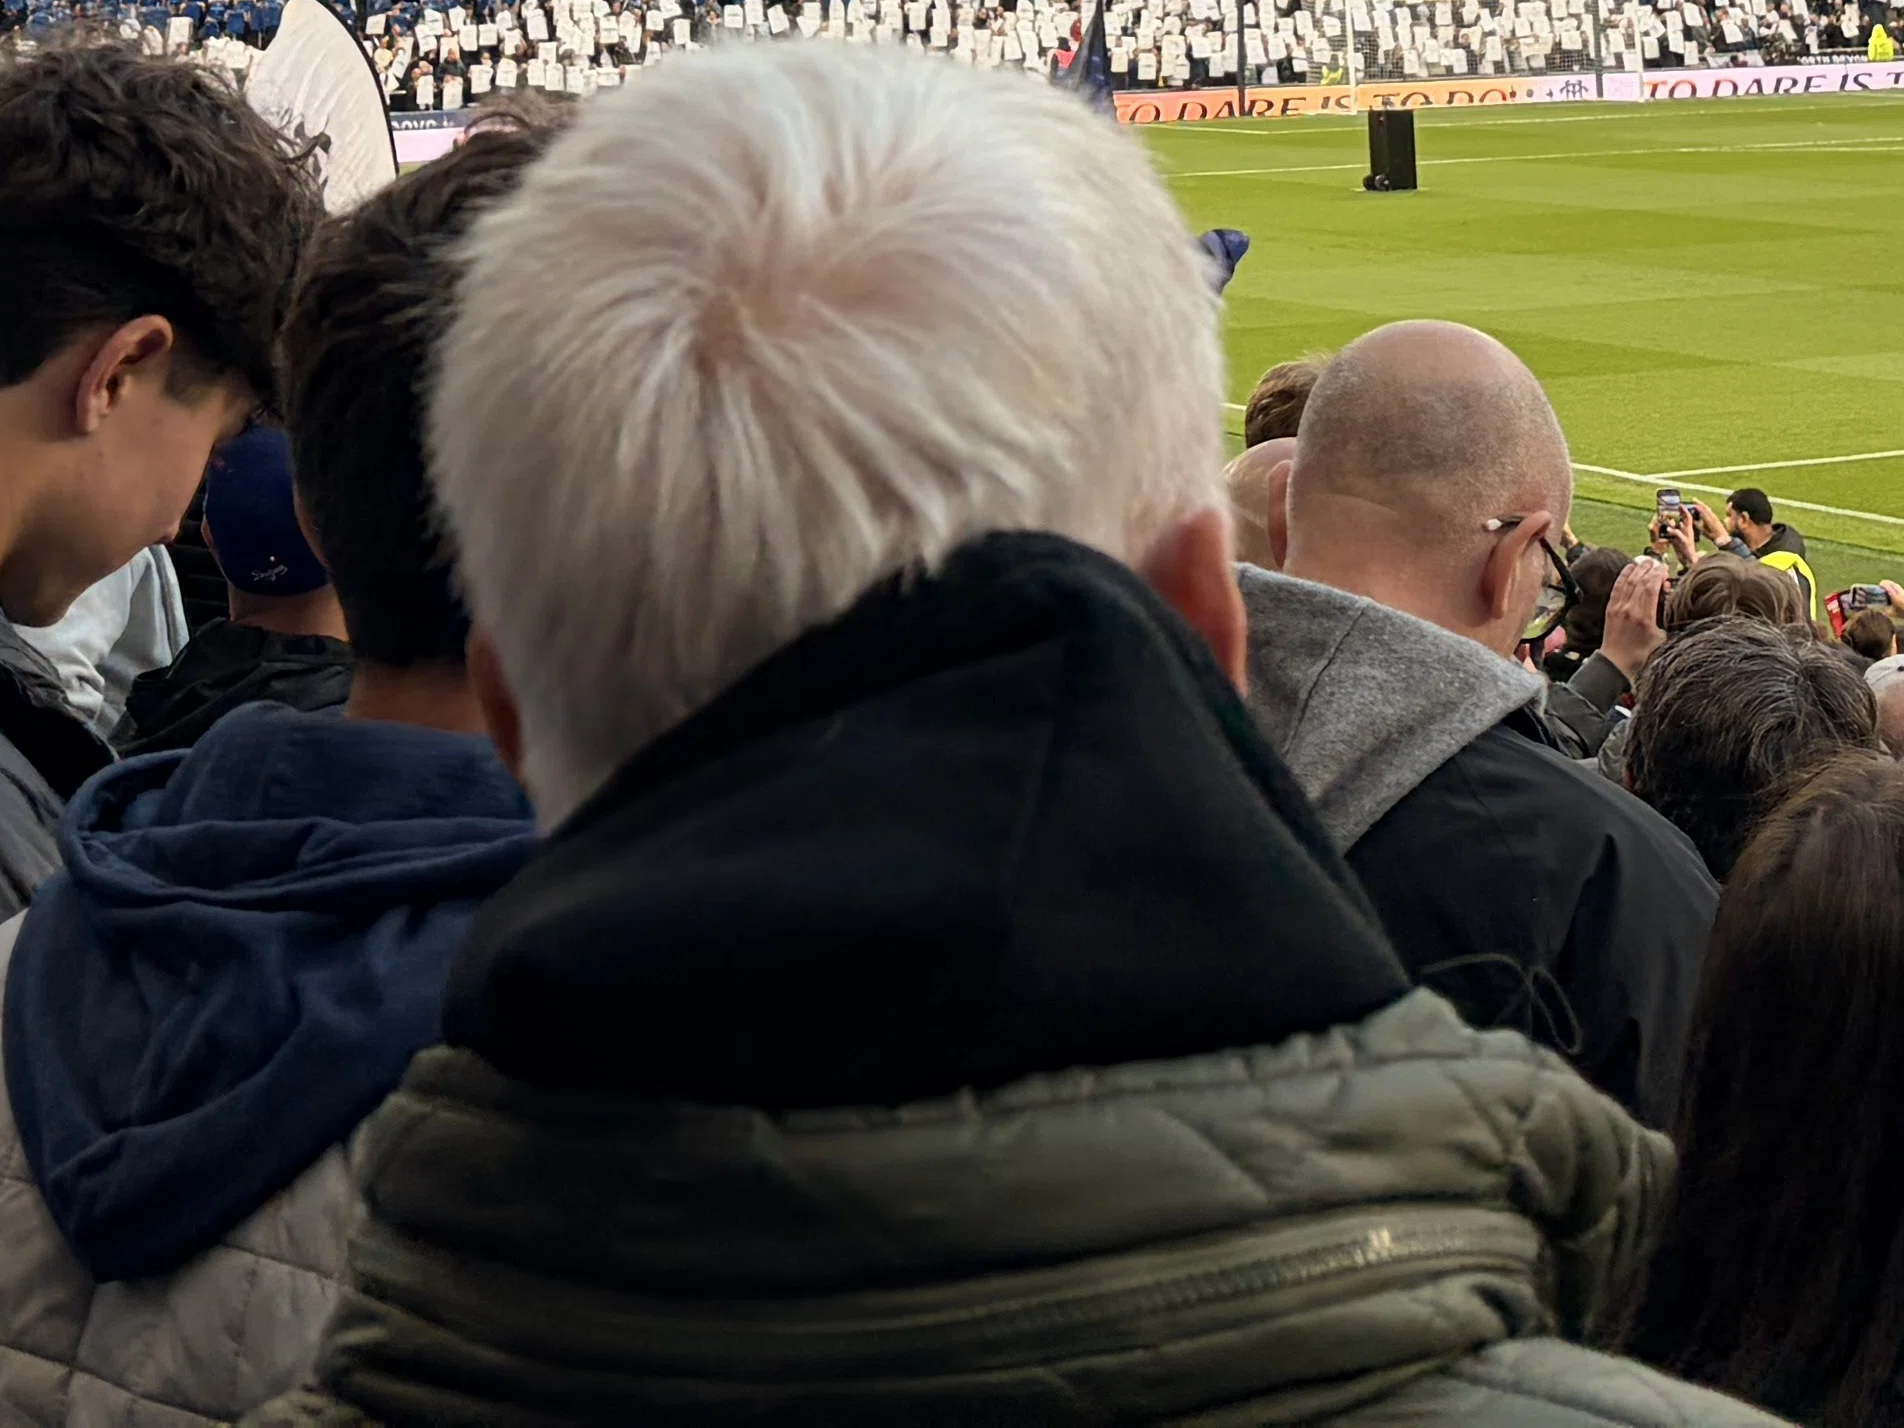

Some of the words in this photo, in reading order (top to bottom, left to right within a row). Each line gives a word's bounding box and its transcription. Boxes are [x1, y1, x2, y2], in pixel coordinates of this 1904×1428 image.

[1642, 79, 1697, 99] TO
[1711, 75, 1828, 97] DARE
[1838, 71, 1873, 92] IS
[1177, 96, 1307, 121] DARE
[1446, 88, 1507, 105] DO
